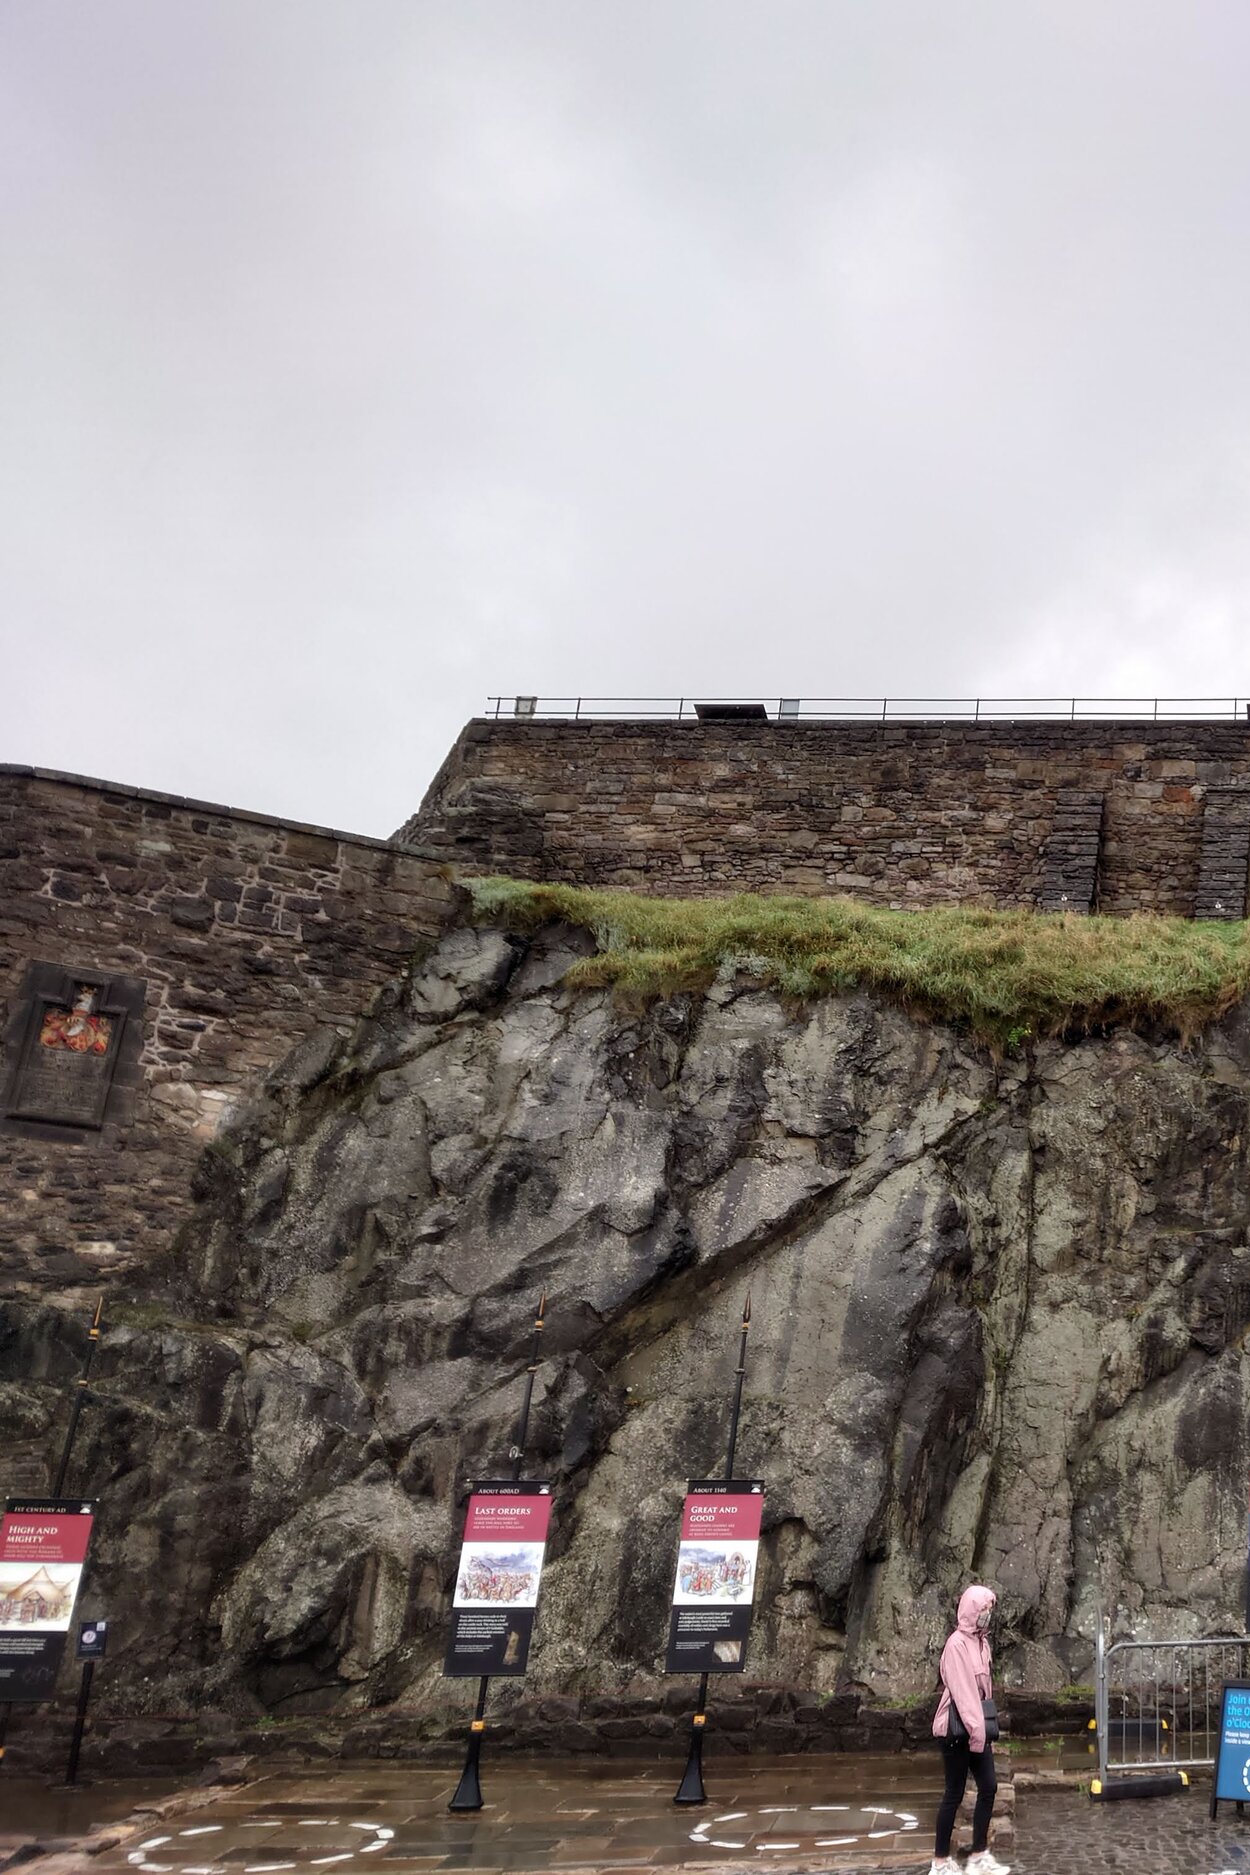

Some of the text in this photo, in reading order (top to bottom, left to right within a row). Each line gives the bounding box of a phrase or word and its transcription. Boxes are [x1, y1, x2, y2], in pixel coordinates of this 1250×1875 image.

[475, 1507, 531, 1515] LAST ORDERS
[690, 1505, 738, 1514] GREAT AND
[9, 1525, 58, 1535] HIGH AND
[6, 1535, 44, 1543] MIGHTY
[1228, 1694, 1246, 1704] Join
[1227, 1705, 1242, 1716] the
